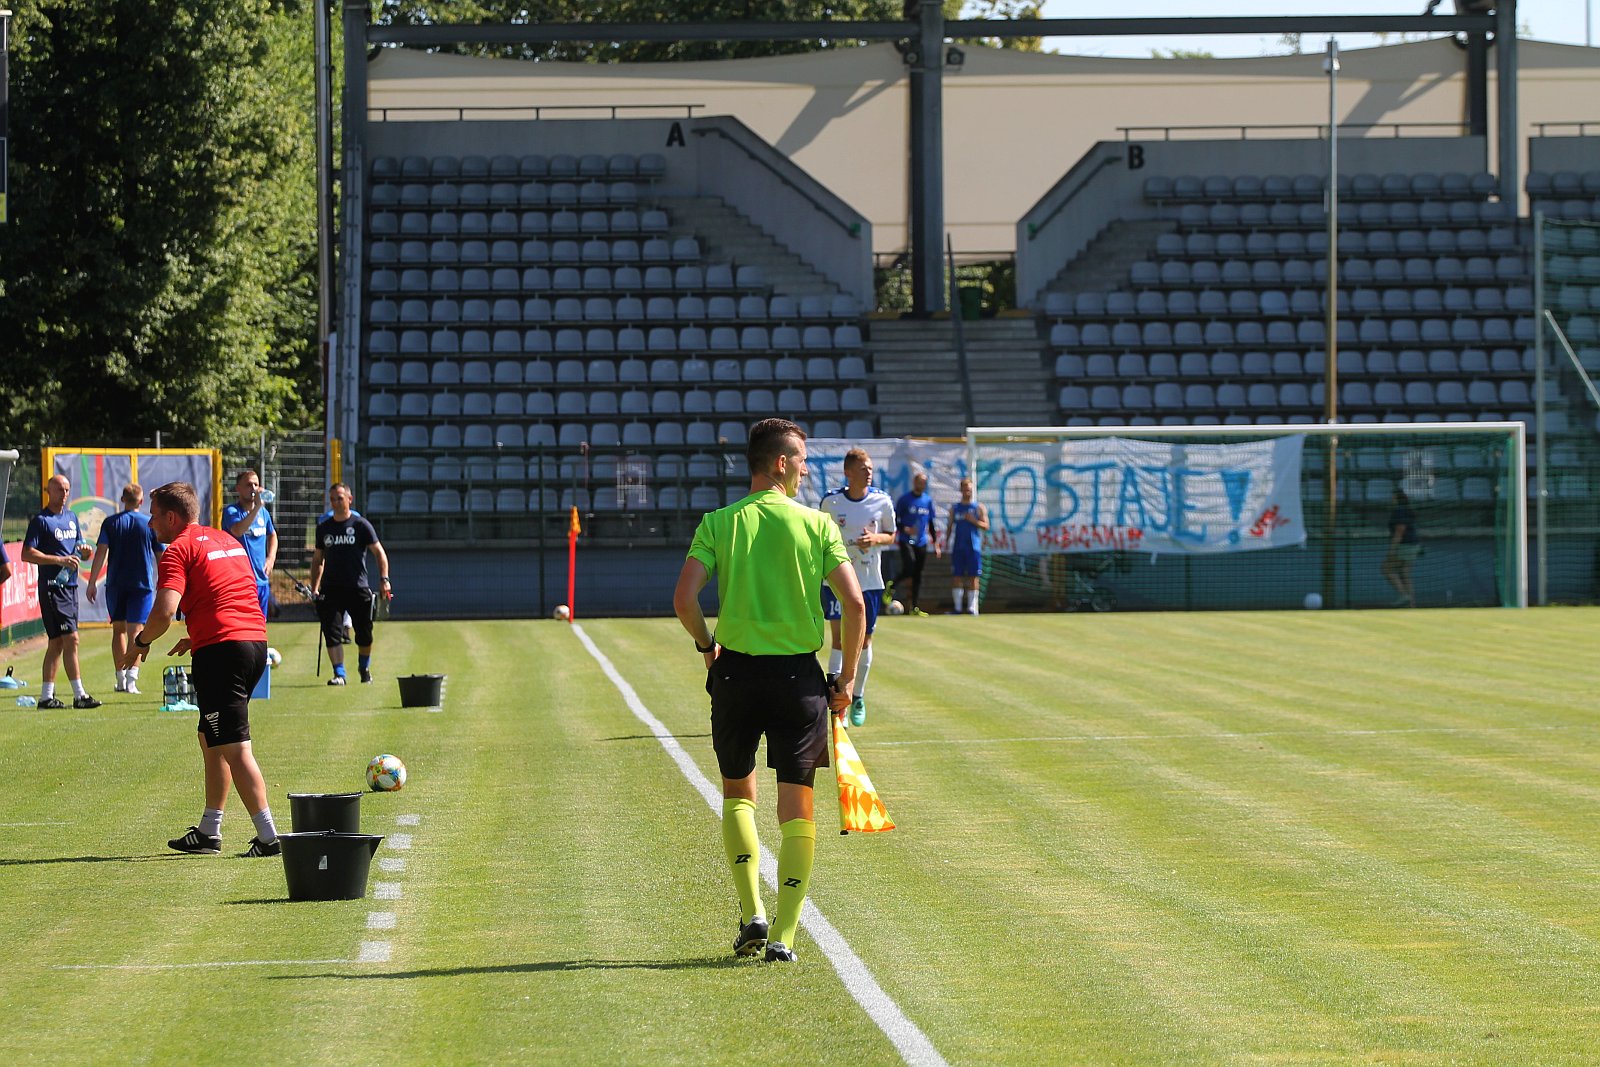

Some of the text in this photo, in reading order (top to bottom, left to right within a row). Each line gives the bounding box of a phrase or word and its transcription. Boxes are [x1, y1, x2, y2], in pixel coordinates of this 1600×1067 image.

[666, 121, 685, 147] A
[1128, 144, 1145, 170] B
[334, 534, 356, 545] JAKO
